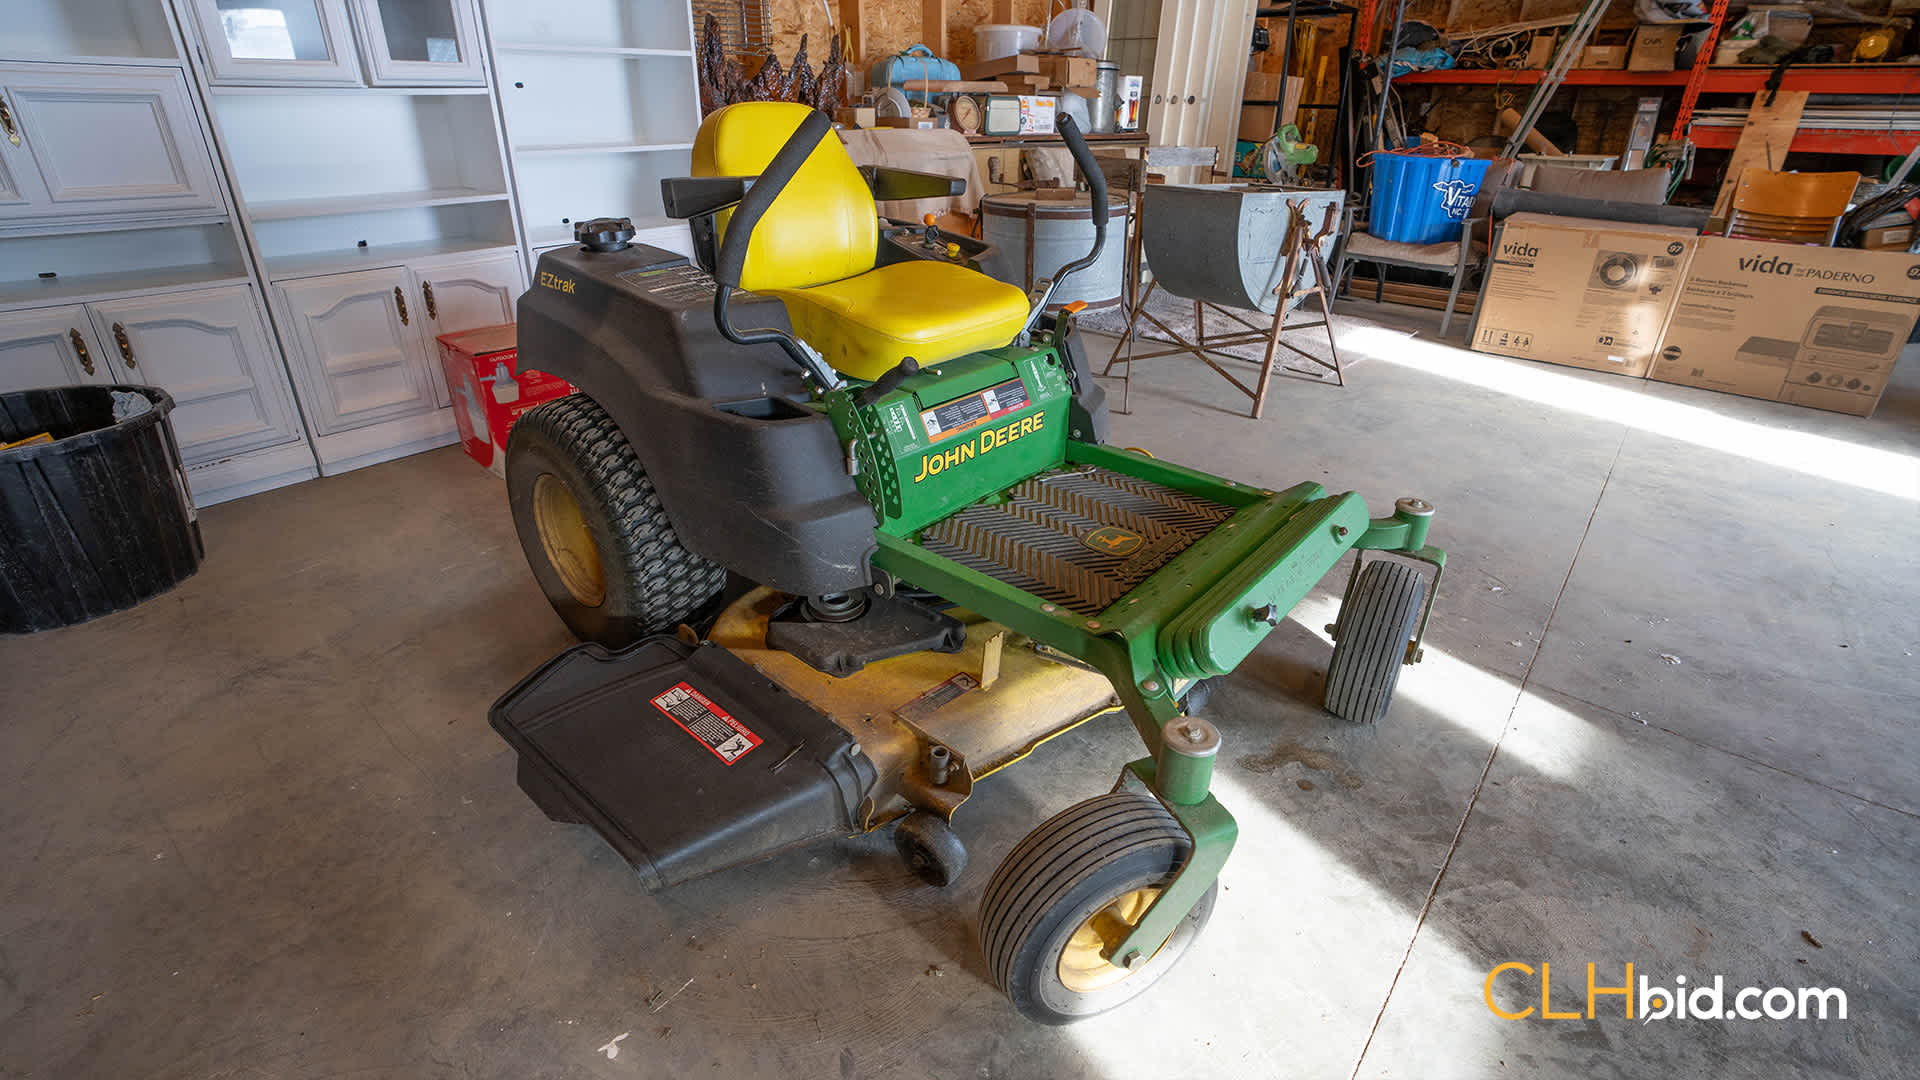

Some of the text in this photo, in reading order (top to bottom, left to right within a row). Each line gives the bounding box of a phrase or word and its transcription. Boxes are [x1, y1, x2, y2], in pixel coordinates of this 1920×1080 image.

[1503, 242, 1539, 258] vida
[540, 271, 576, 295] EZtrak
[1738, 254, 1794, 275] vida
[1806, 268, 1875, 285] PADERNO
[914, 438, 976, 484] JOHN
[979, 410, 1045, 455] DEERE
